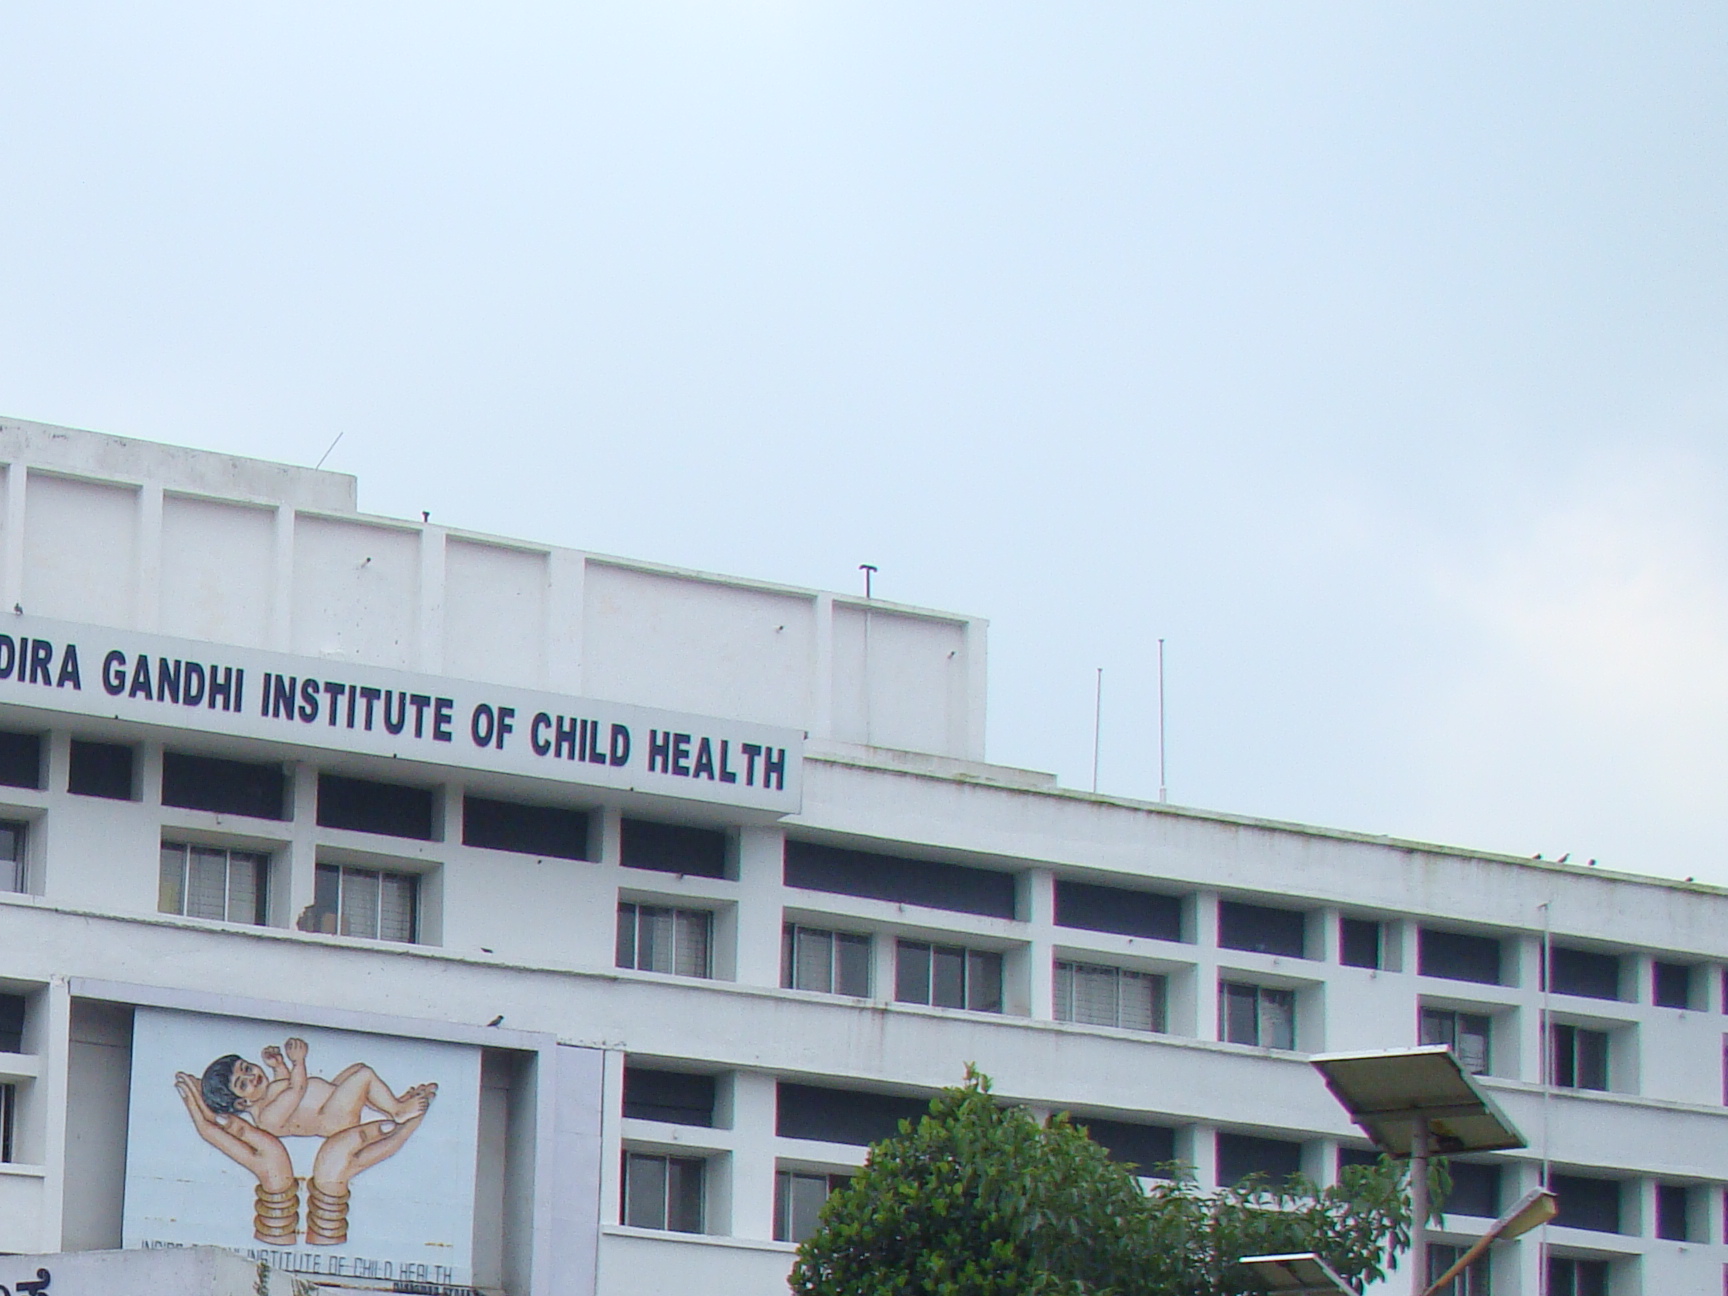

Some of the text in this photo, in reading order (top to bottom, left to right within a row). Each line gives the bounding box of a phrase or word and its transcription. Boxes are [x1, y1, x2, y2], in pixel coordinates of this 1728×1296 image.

[102, 649, 244, 713] GANDHI
[261, 672, 454, 743] INSTITUTE
[471, 703, 515, 750] OF
[531, 712, 630, 767] CHILD
[648, 729, 785, 791] HEALTH
[328, 1255, 346, 1275] OF
[354, 1257, 392, 1279] CHILD
[399, 1262, 452, 1284] HEALTH
